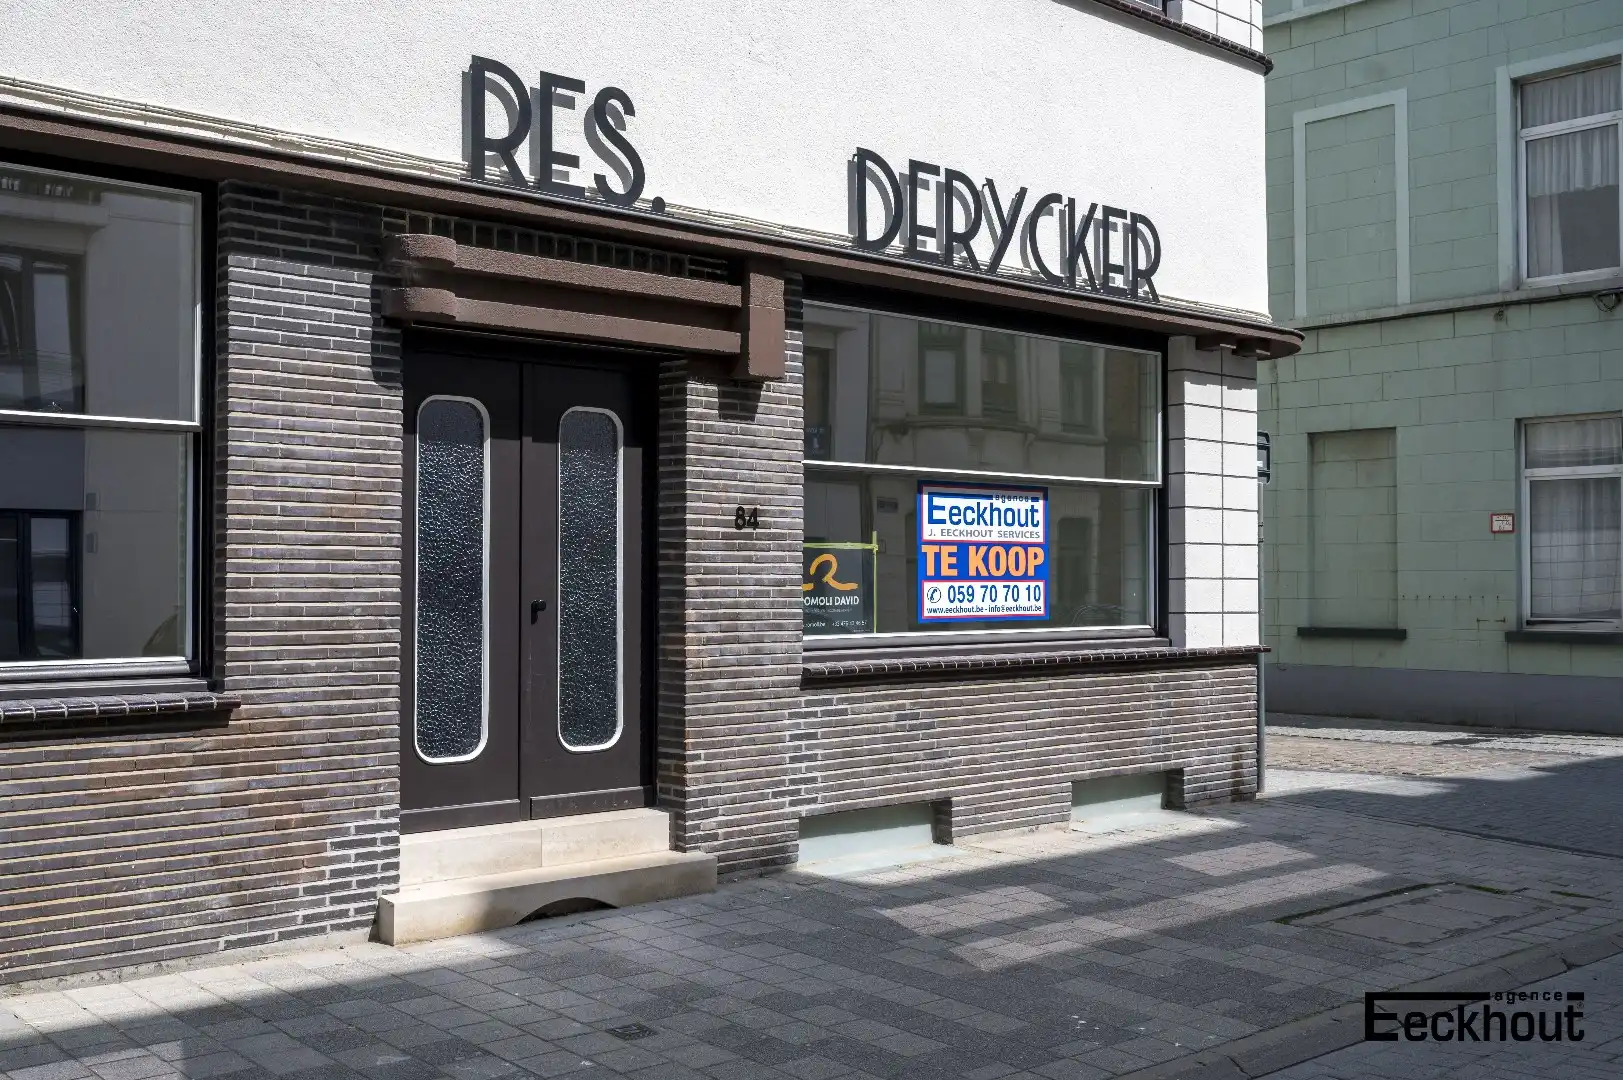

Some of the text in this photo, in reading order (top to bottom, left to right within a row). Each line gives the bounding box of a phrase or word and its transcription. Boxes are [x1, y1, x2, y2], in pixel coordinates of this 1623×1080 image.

[471, 54, 1162, 303] RES. DERYCKER
[995, 494, 1029, 504] agence
[735, 505, 760, 531] 84
[928, 492, 1040, 528] Eeckhout
[928, 528, 1041, 539] J. EECKHOUT SERVICES
[921, 545, 1045, 577] TE KOOP
[801, 595, 860, 606] OMOLI DAVID
[947, 584, 1042, 603] 059 70 70 10
[926, 605, 984, 614] www.eeckhout.be
[988, 604, 1042, 613] info@eeckhout.be
